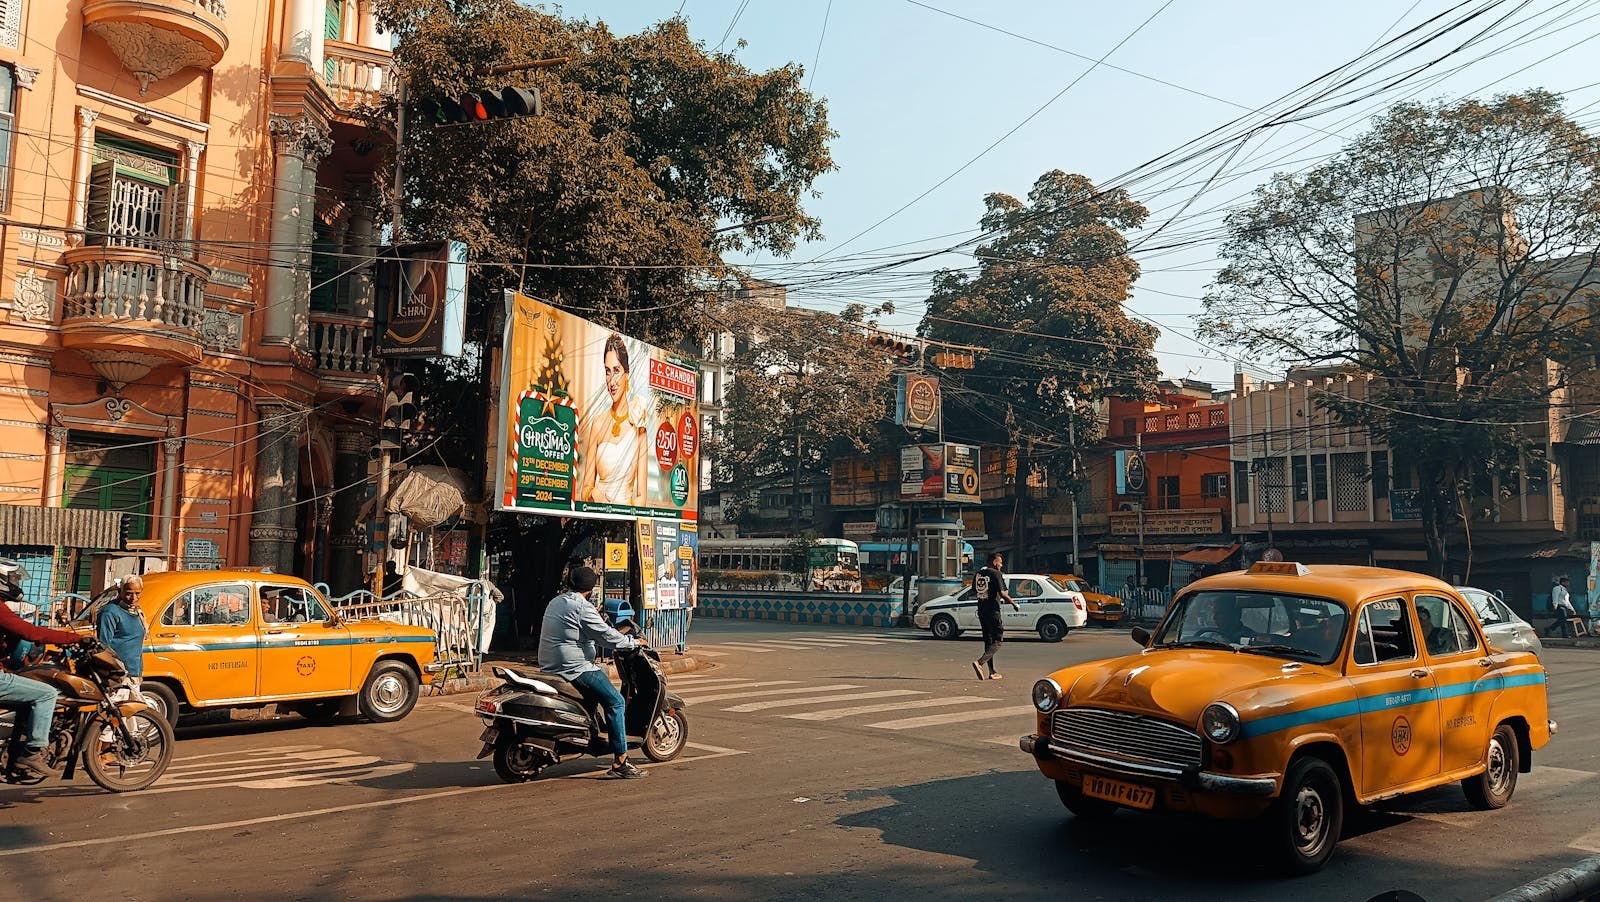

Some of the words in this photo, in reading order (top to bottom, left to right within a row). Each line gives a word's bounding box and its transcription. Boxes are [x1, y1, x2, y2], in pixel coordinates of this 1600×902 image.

[665, 366, 695, 386] CHANDRA
[520, 425, 571, 455] CHRISTMAS
[544, 449, 565, 460] OFFER
[522, 457, 535, 467] 13TH
[535, 459, 569, 472] DECEMBER
[521, 475, 535, 485] 29TH
[535, 477, 569, 489] DECEMBER
[535, 490, 553, 502] 2024
[1259, 563, 1294, 575] TAXI
